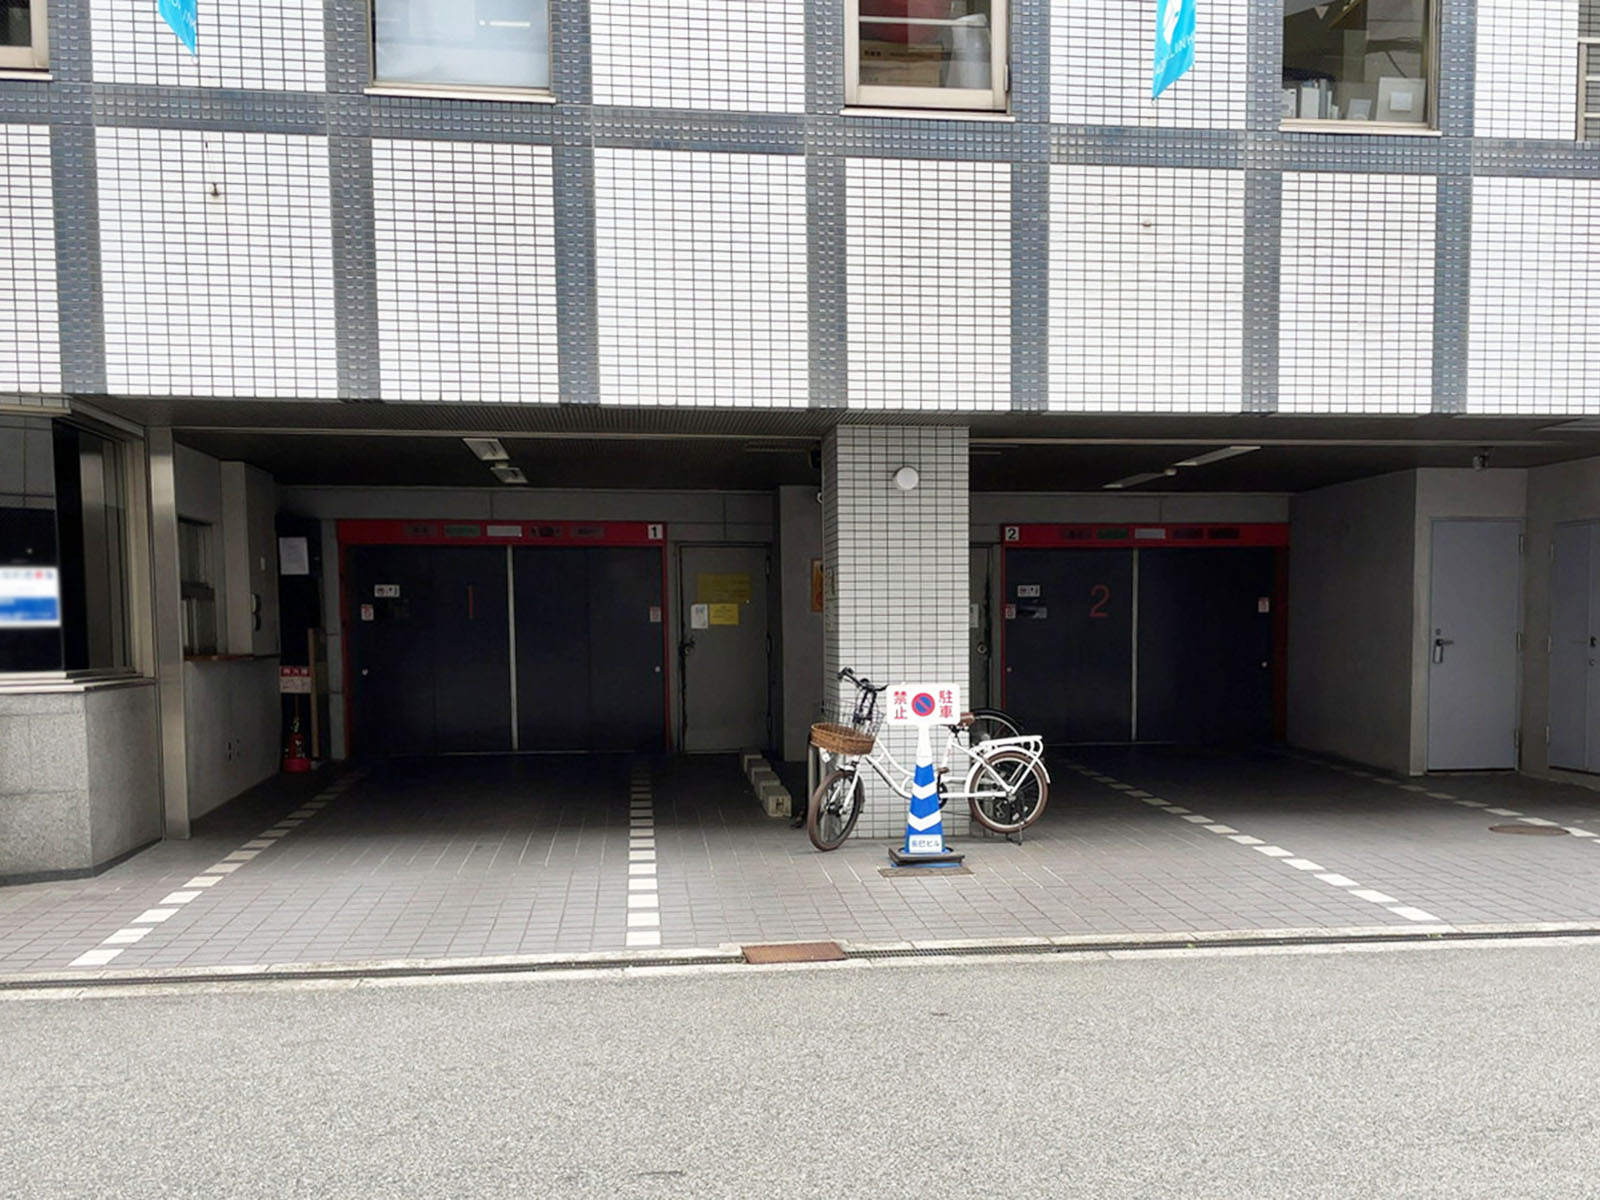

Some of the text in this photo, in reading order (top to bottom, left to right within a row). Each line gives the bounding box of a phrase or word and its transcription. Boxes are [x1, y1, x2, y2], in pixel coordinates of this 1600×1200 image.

[651, 526, 658, 538] 1
[1008, 527, 1017, 540] 2
[1090, 585, 1111, 618] 2
[894, 691, 907, 719] 禁止
[939, 690, 953, 718] 駐車
